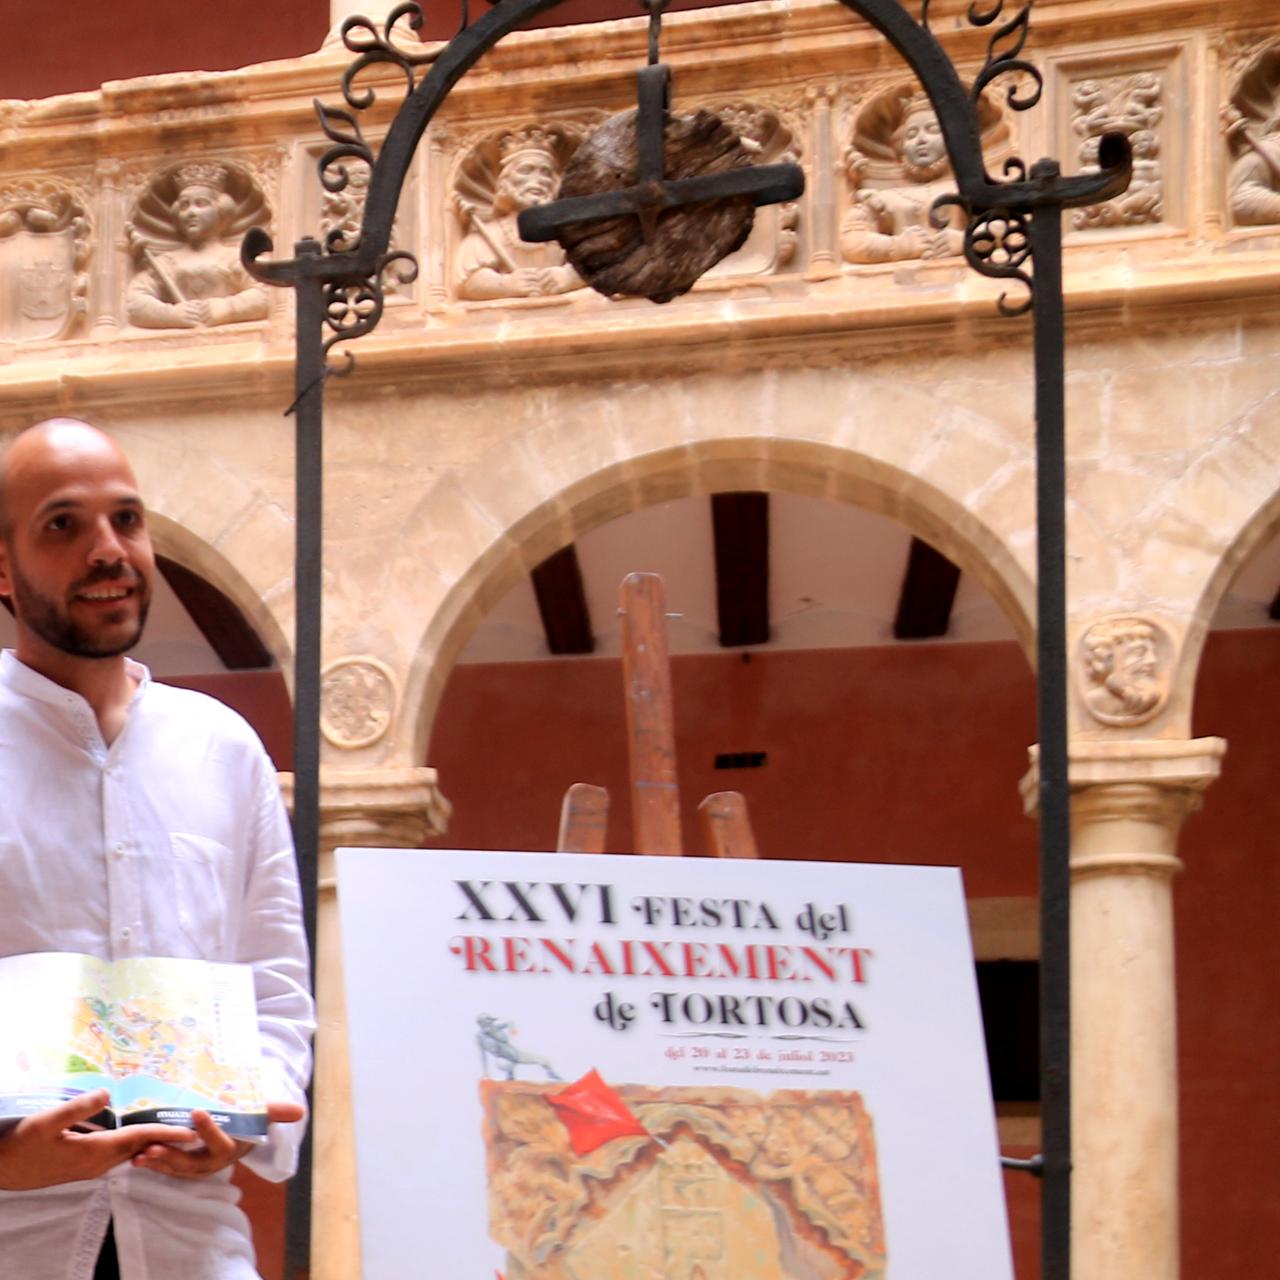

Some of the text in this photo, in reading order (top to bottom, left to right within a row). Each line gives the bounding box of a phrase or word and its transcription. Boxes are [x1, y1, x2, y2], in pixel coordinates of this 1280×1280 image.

[453, 880, 850, 940] XXVI FESTA del
[448, 935, 873, 983] RENAIXEMENT
[594, 991, 865, 1030] de TORTOSA
[733, 1048, 750, 1060] 23
[819, 1051, 854, 1063] 2023
